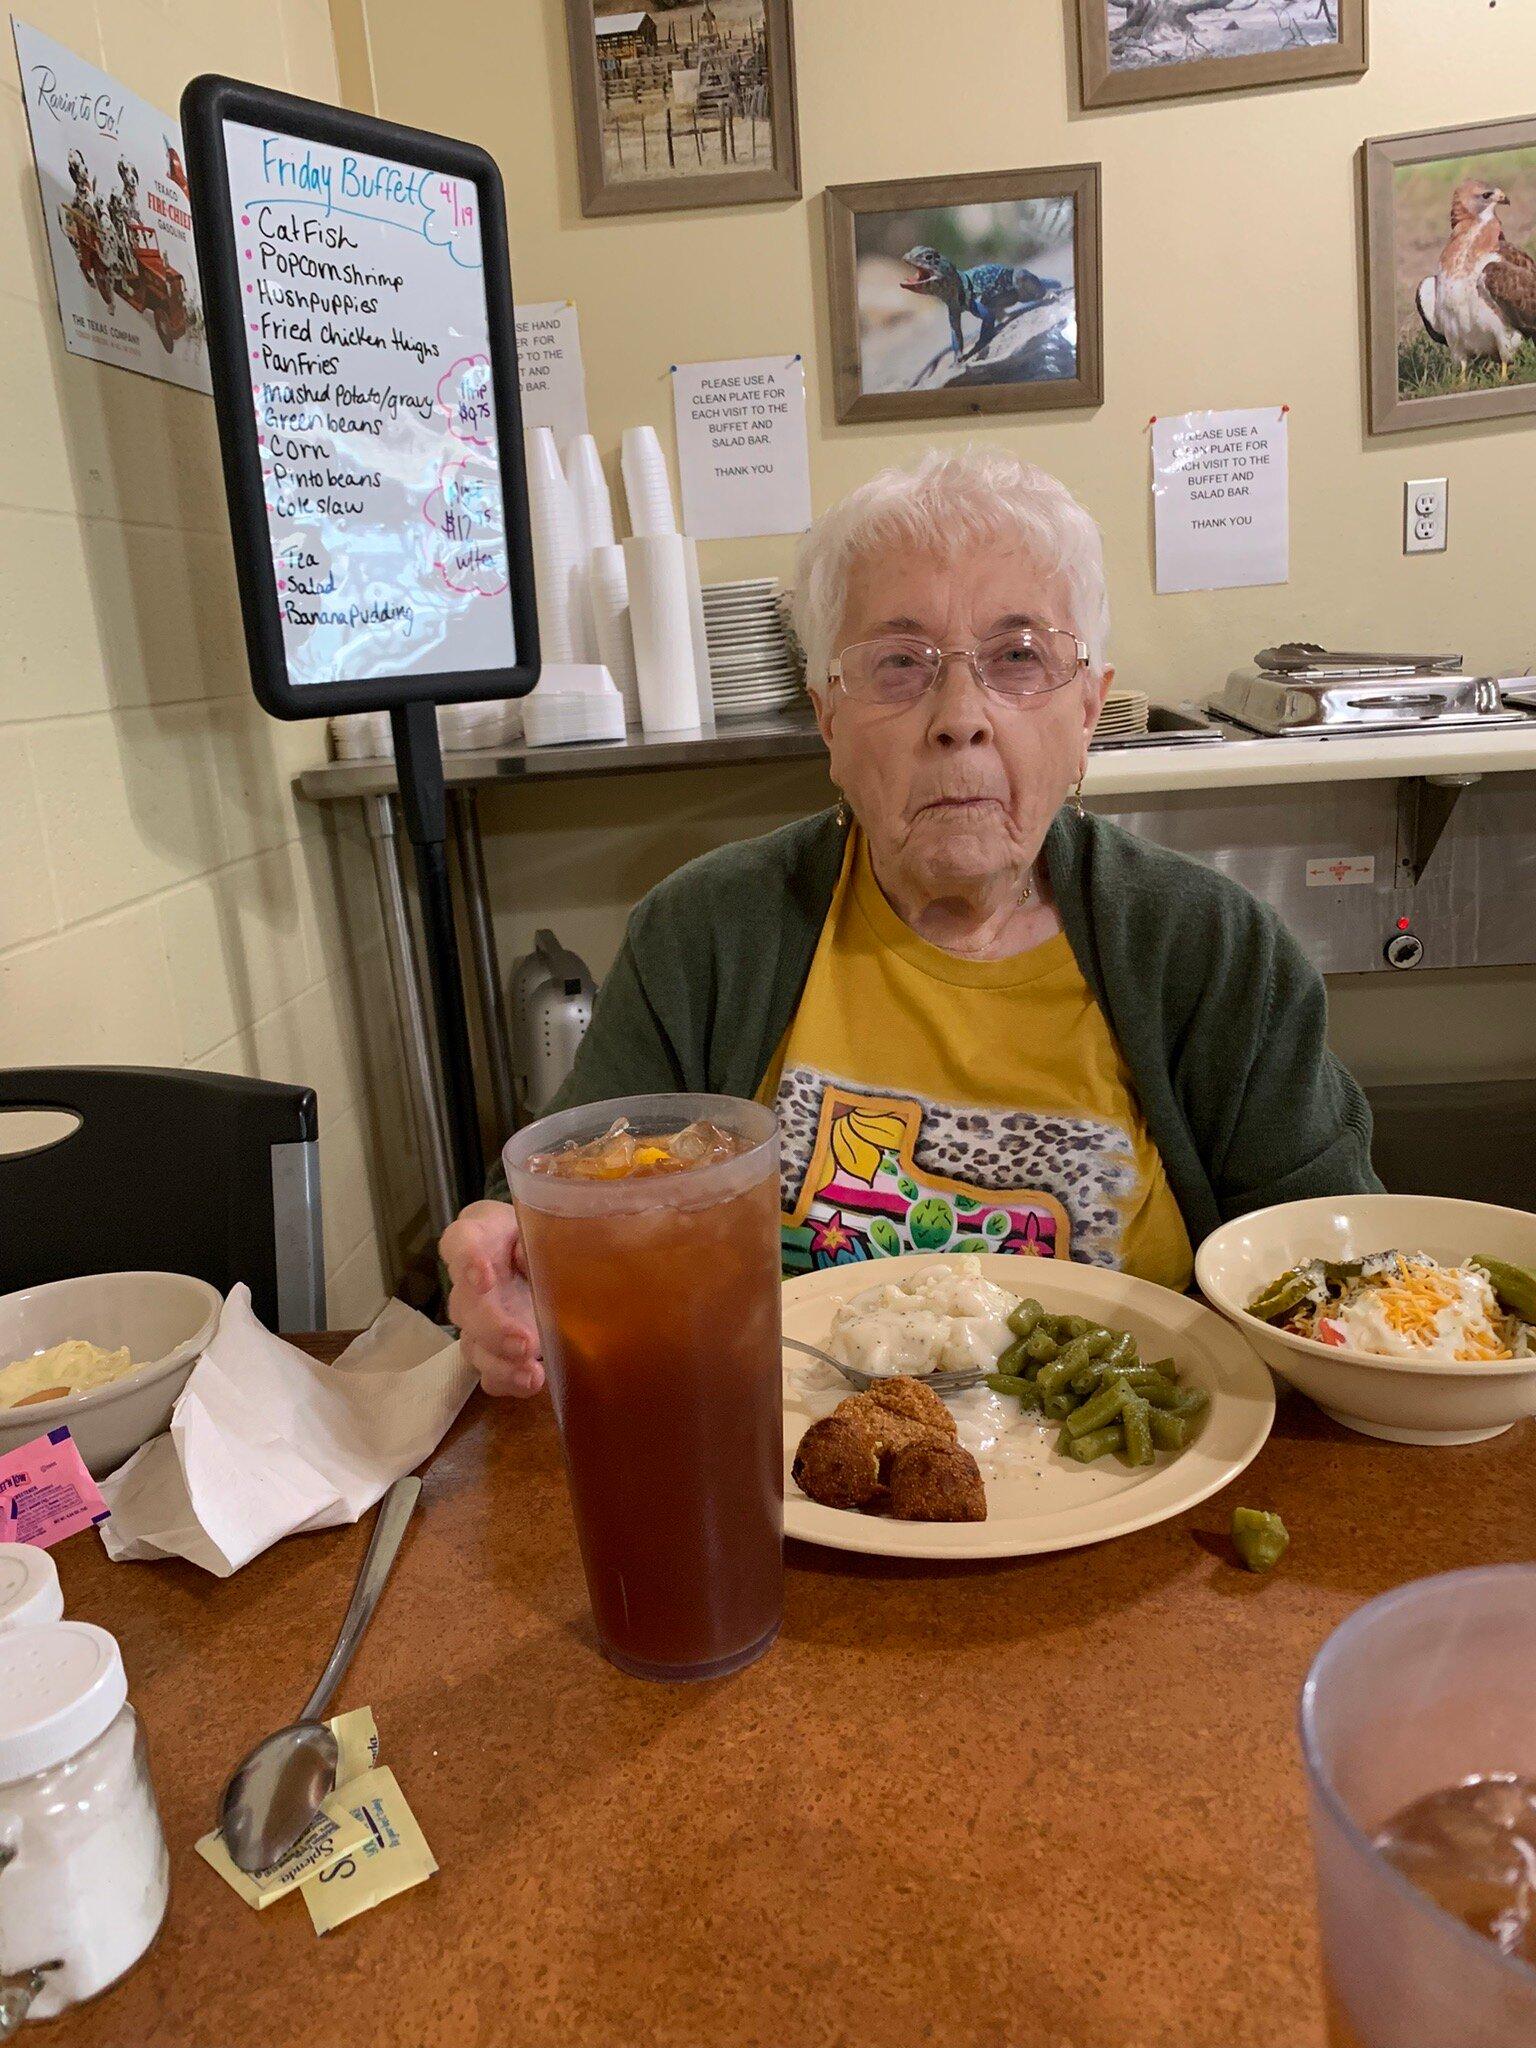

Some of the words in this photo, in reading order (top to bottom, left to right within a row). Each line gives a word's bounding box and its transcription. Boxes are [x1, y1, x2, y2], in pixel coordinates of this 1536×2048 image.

[94, 94, 125, 135] Go!
[262, 137, 332, 218] Friday
[341, 156, 419, 205] Buffet
[260, 311, 312, 344] Fried
[515, 322, 530, 333] SE
[532, 319, 562, 331] HAND
[533, 334, 556, 346] FOR
[526, 351, 541, 361] TO
[543, 349, 564, 360] THE
[528, 365, 551, 377] AND
[525, 381, 551, 392] BAR.
[701, 377, 741, 389] PLEASE
[743, 375, 765, 386] USE
[767, 374, 775, 384] A
[692, 393, 727, 405] CLEAN
[729, 390, 761, 402] PLATE
[763, 388, 786, 399] FOR
[691, 408, 720, 420] EACH
[722, 406, 748, 417] VISIT
[751, 405, 765, 415] TO
[768, 403, 788, 414] THE
[708, 421, 748, 434] BUFFET
[751, 419, 773, 430] AND
[1184, 429, 1223, 441] EASE
[1226, 426, 1248, 438] USE
[1250, 426, 1259, 436] A
[711, 436, 745, 448] SALAD
[1210, 442, 1243, 454] PLATE
[1245, 440, 1268, 451] FOR
[1202, 458, 1229, 470] VISIT
[1232, 456, 1247, 467] TO
[1249, 454, 1271, 465] THE
[714, 466, 749, 477] THANK
[750, 463, 774, 475] YOU
[1188, 473, 1229, 486] BUFFET
[1231, 471, 1254, 482] AND
[1190, 488, 1225, 501] SALAD
[1191, 518, 1227, 530] THANK
[1228, 515, 1252, 527] YOU
[280, 1838, 335, 1883] Splenda
